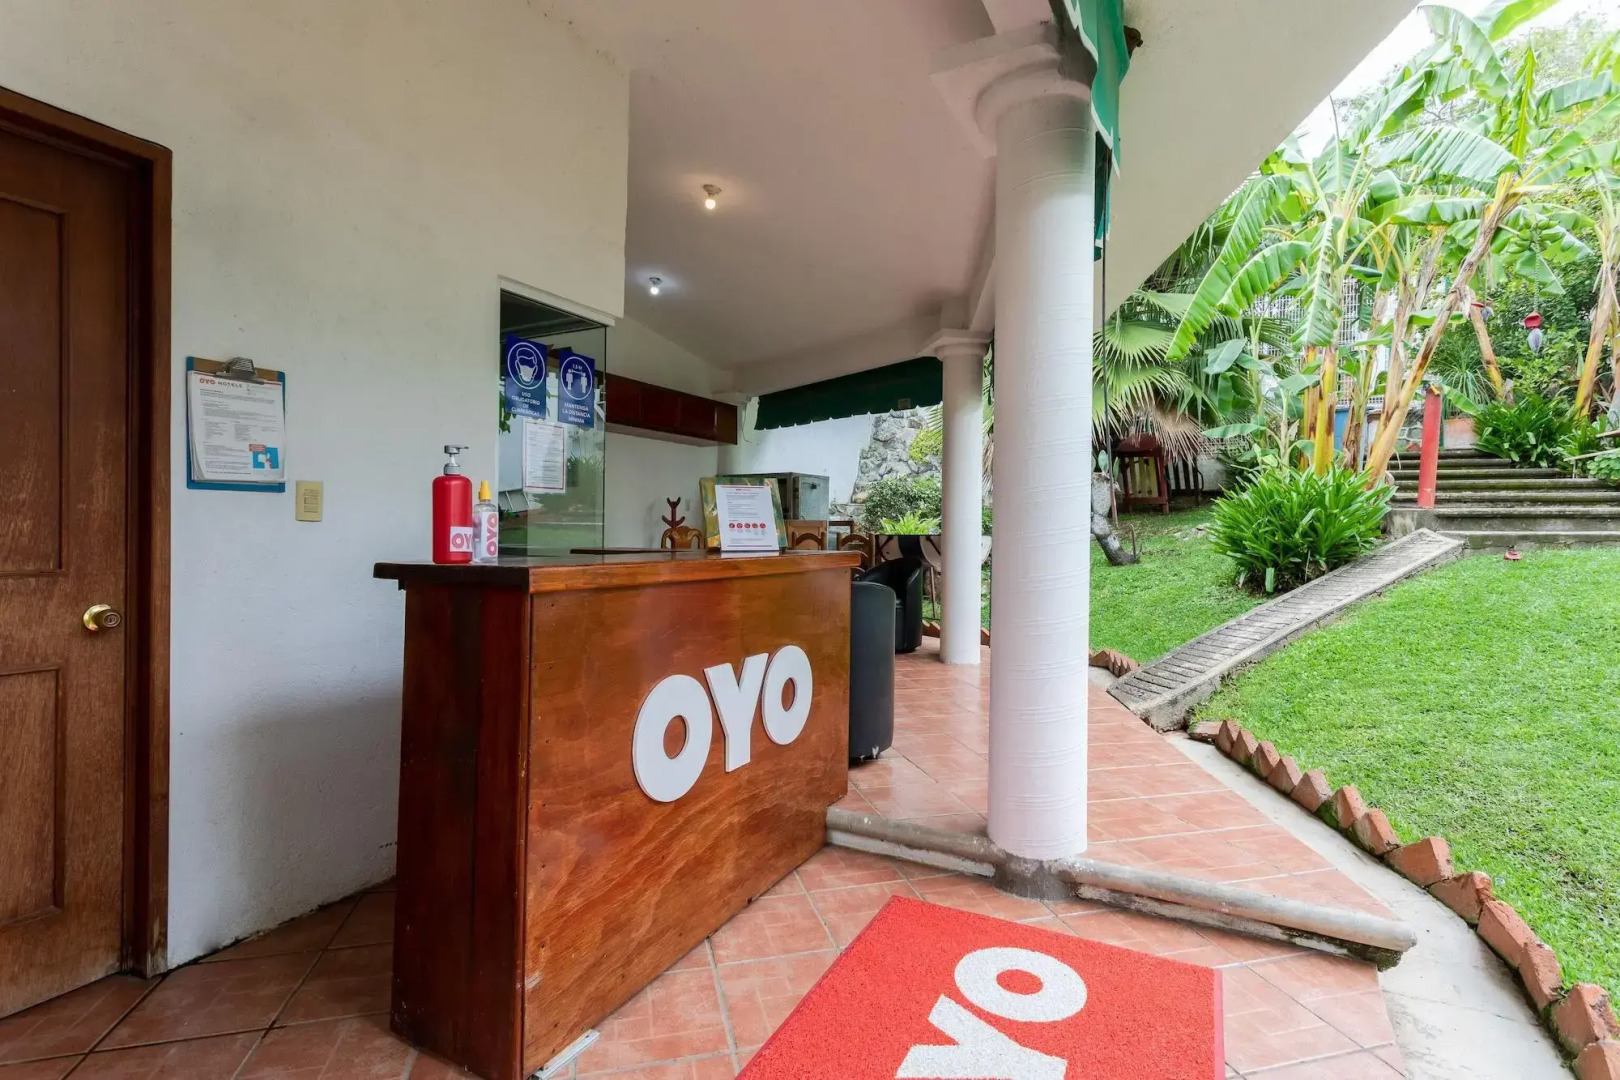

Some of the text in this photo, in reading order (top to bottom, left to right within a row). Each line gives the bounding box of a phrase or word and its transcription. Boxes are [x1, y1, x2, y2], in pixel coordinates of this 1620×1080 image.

[217, 381, 243, 389] HOTELS
[511, 395, 541, 406] OBLIGATORIO
[564, 402, 589, 411] MANTENGA
[569, 409, 591, 418] DISTANCIA
[486, 513, 498, 556] OYO
[451, 533, 473, 550] OY
[632, 645, 813, 802] OYO
